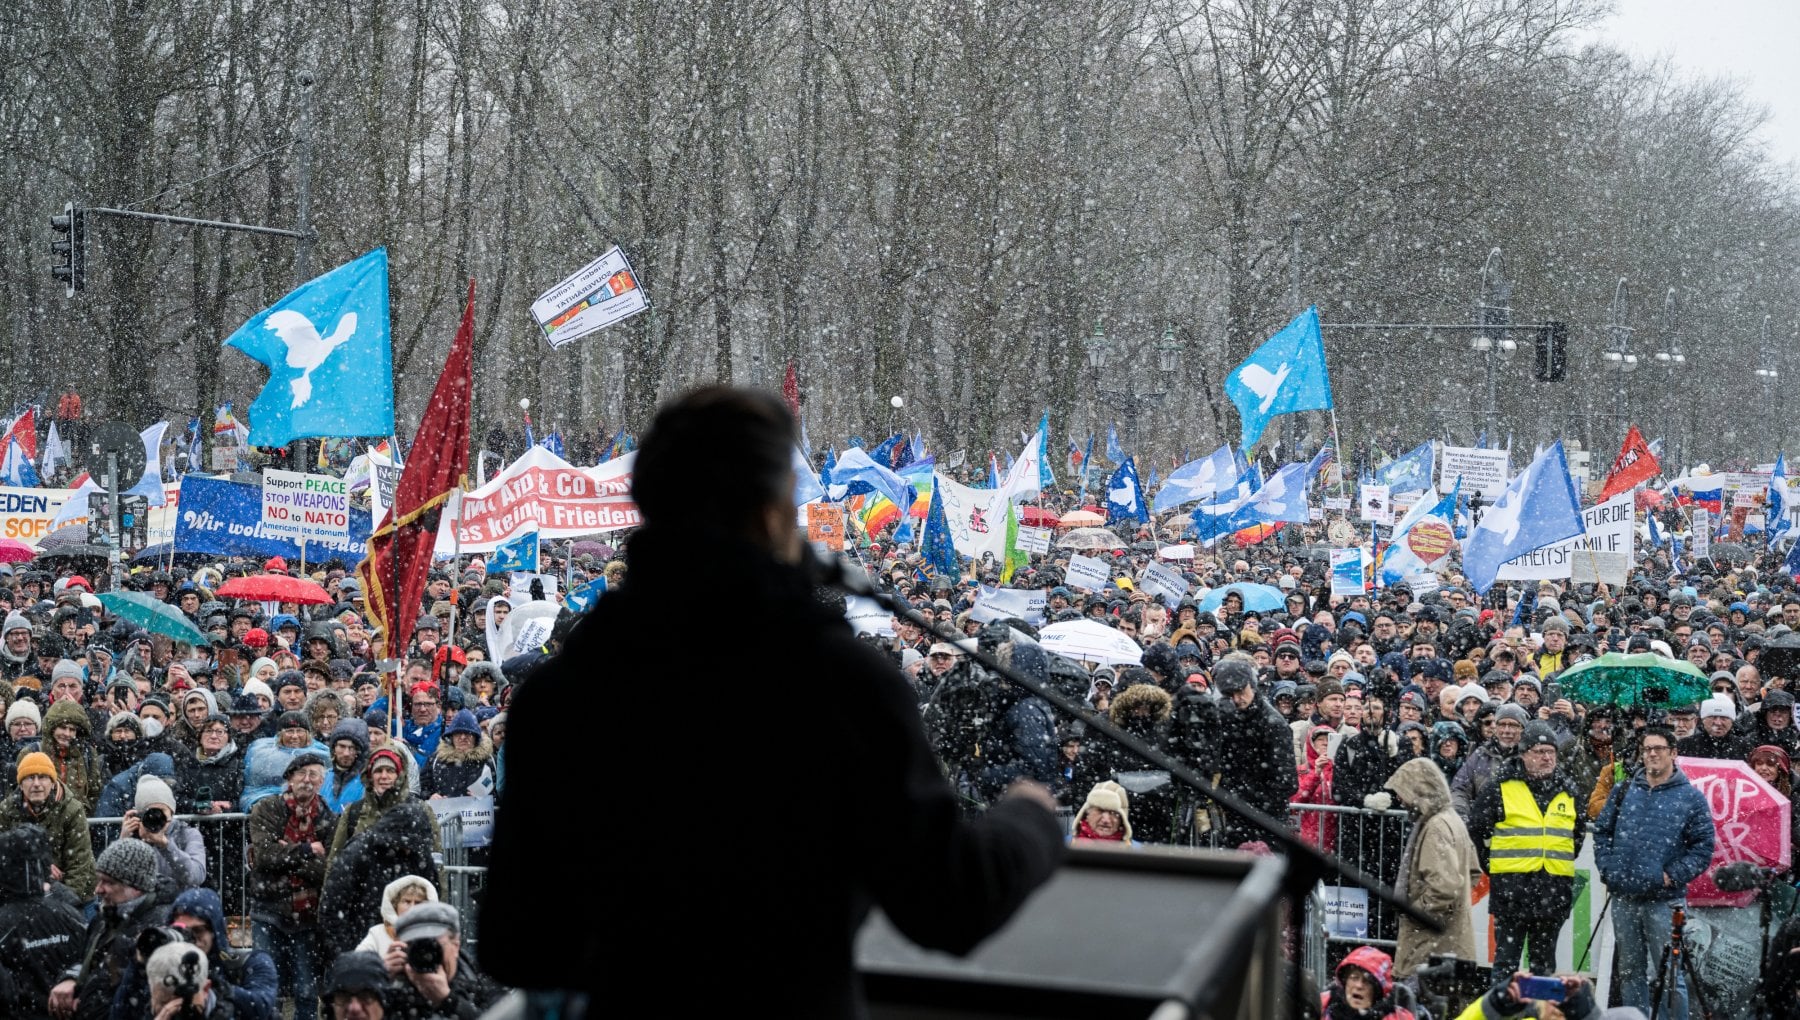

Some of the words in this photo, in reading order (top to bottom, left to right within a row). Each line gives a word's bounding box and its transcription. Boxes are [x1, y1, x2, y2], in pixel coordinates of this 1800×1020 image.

[266, 476, 303, 490] Support
[305, 479, 346, 495] PEACE
[464, 500, 496, 520] Mt
[501, 474, 534, 507] AfD
[538, 473, 549, 495] &
[265, 492, 290, 504] STOP
[293, 491, 346, 511] WEAPONS
[184, 510, 224, 532] Wir
[268, 506, 289, 520] NO
[291, 513, 301, 523] to
[304, 511, 346, 527] NATO
[459, 523, 483, 542] es
[554, 505, 640, 527] Frieden
[1585, 507, 1610, 528] FÜR
[1612, 502, 1631, 522] DIE
[262, 521, 299, 533] Americani
[301, 527, 312, 535] ite
[314, 527, 349, 538] domum!
[1689, 774, 1760, 823] TOP
[1711, 822, 1766, 865] AR
[1326, 900, 1349, 908] MATIE
